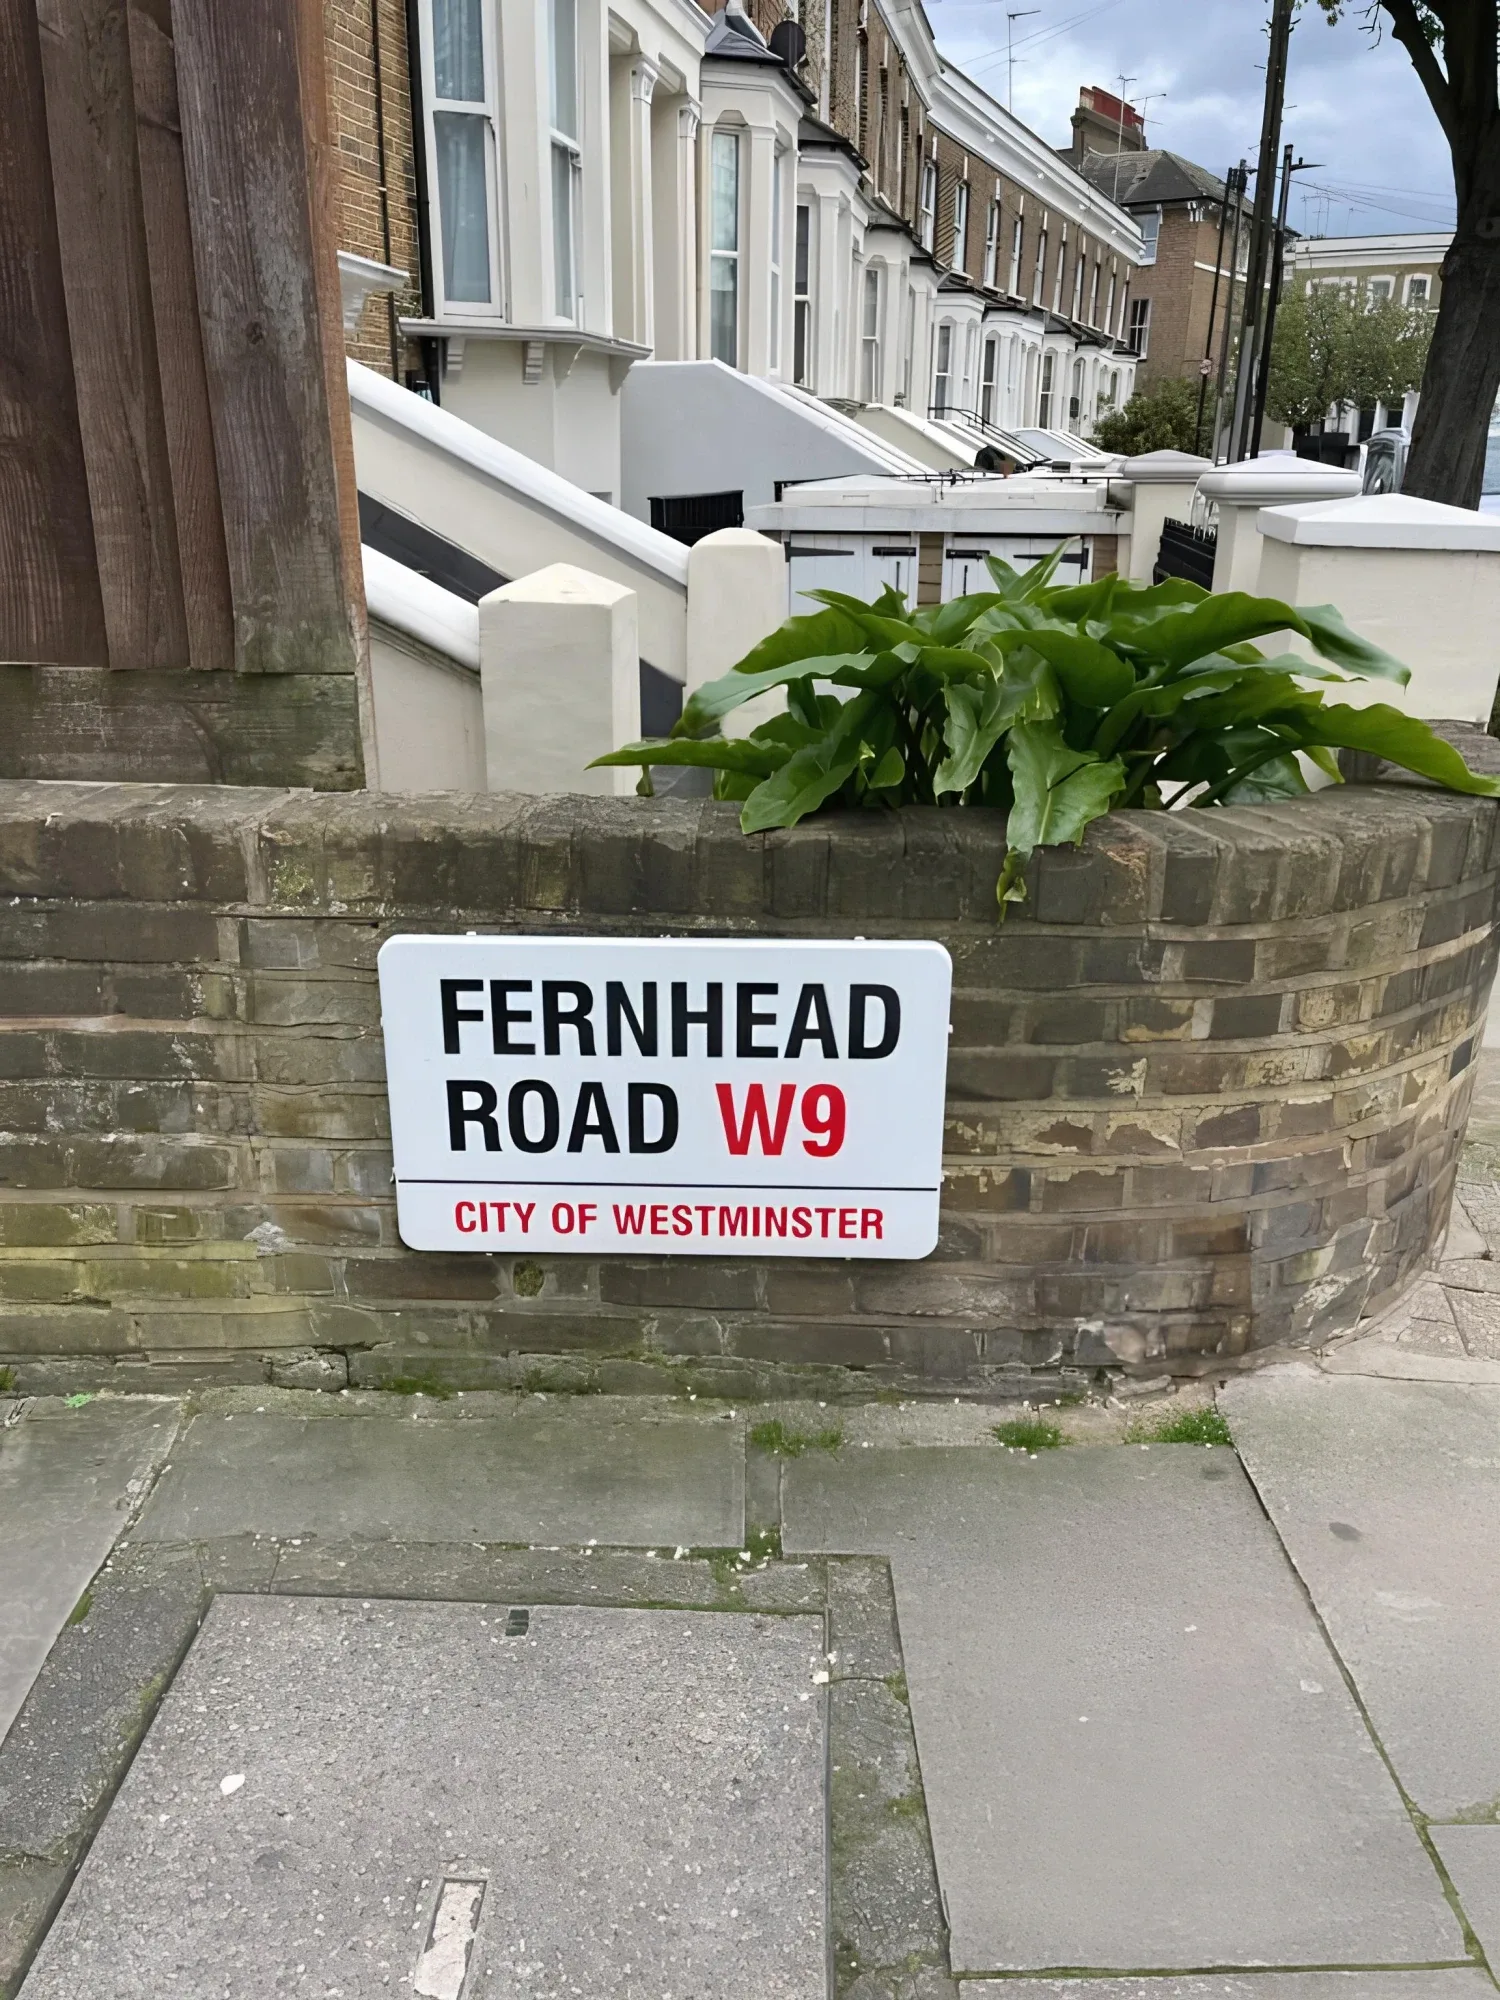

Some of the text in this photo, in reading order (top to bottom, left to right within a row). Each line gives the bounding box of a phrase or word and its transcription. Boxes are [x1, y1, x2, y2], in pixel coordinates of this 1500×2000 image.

[440, 978, 901, 1060] FERNHEAD
[445, 1079, 846, 1158] ROAD W9
[455, 1201, 884, 1240] CITY OF WESTMINSTER
